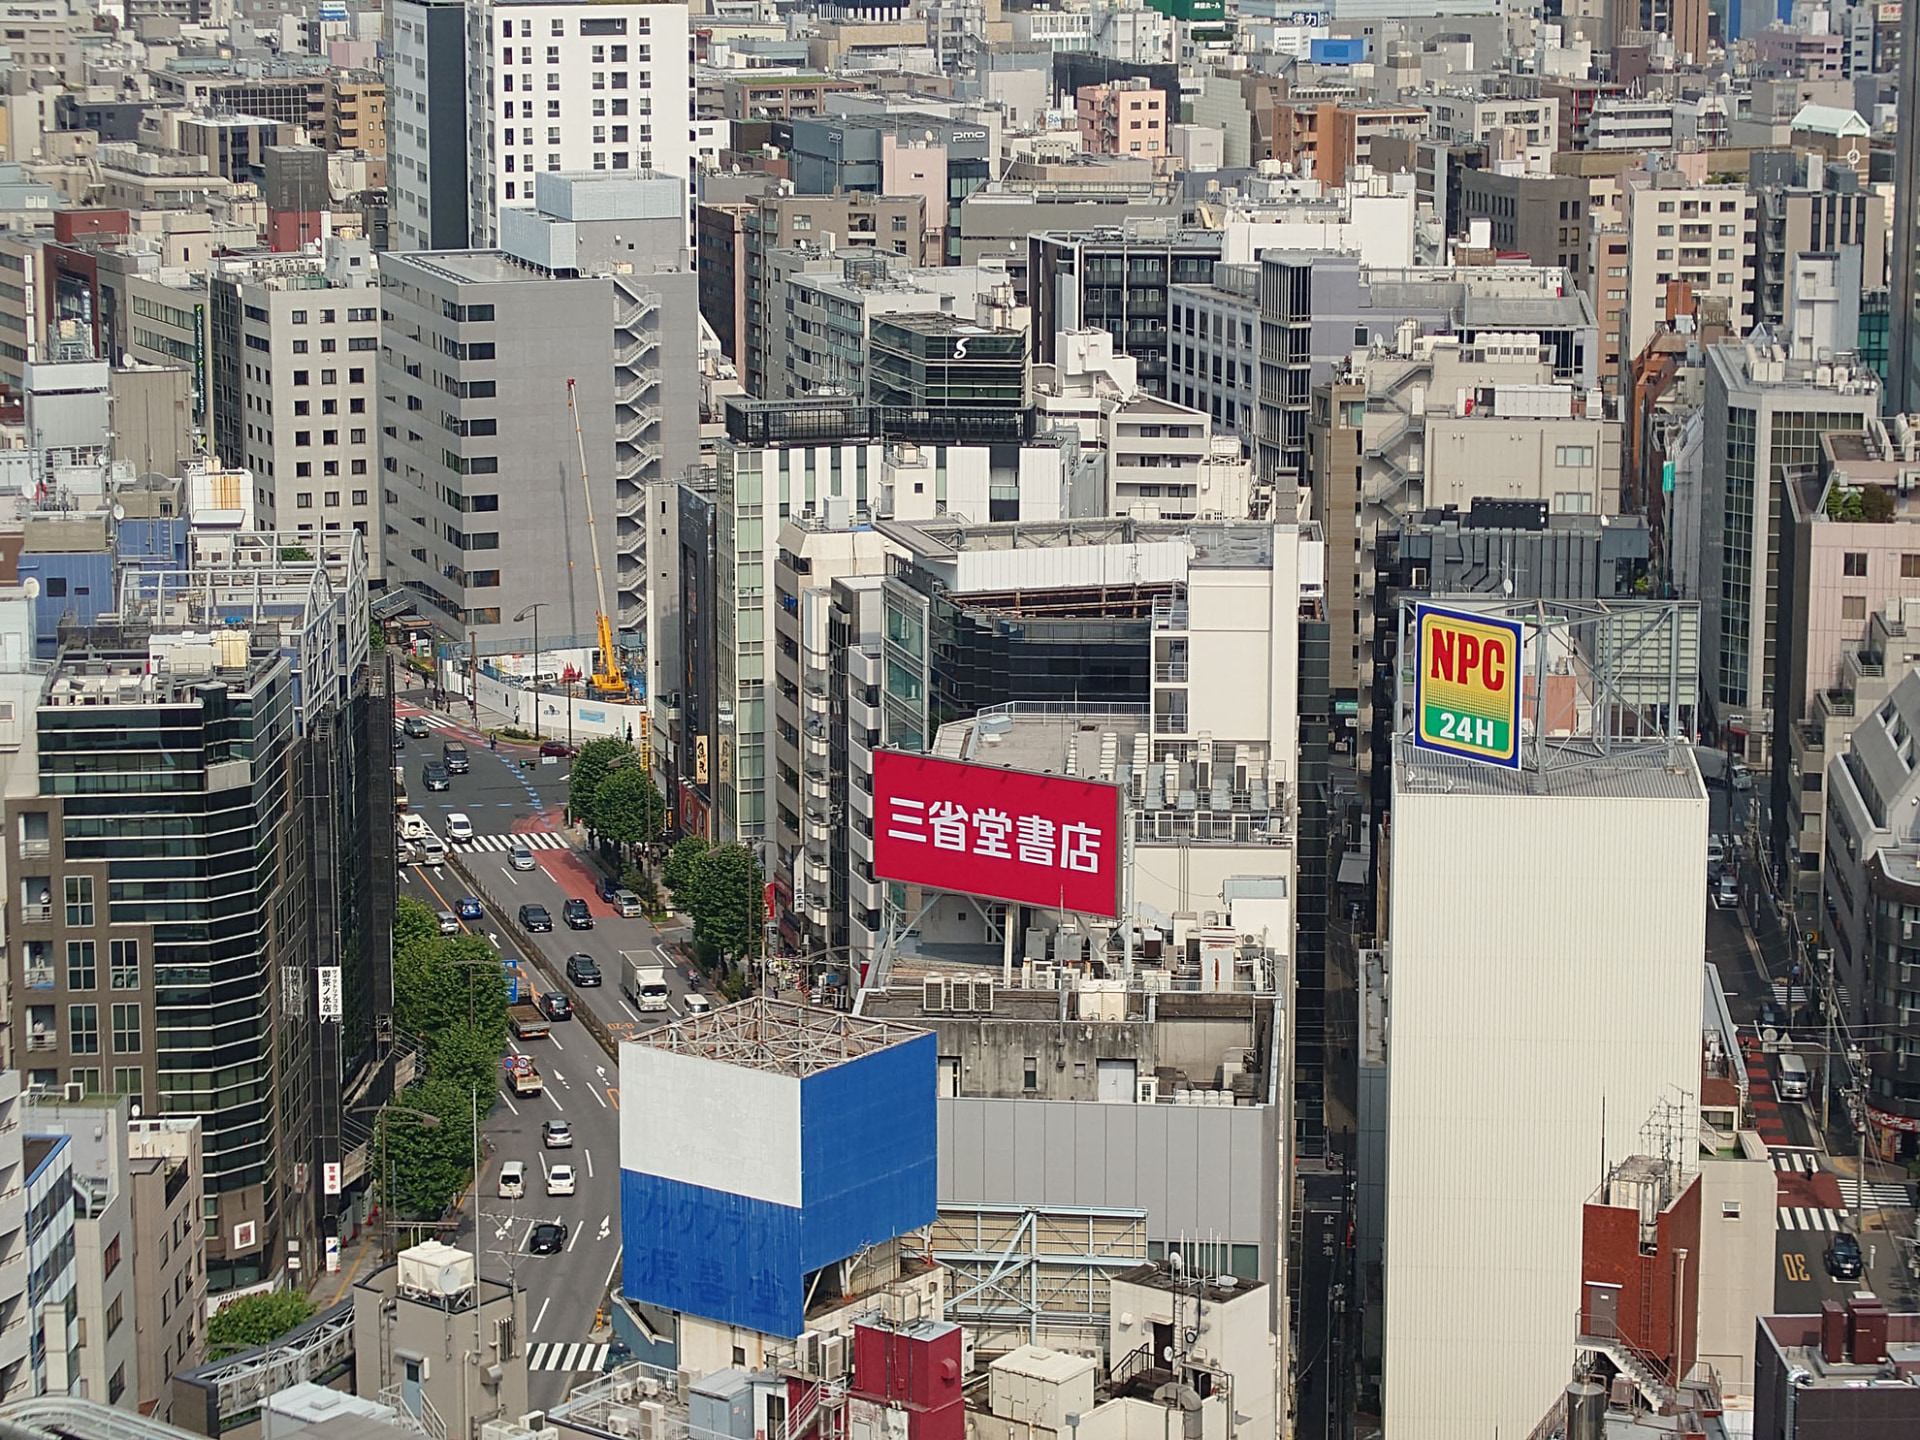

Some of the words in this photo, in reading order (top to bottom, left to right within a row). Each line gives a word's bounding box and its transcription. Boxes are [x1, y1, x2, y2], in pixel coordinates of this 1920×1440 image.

[1431, 628, 1505, 692] NPC
[1440, 712, 1494, 748] 24H
[888, 797, 1102, 873] 三省堂書店
[322, 970, 331, 1013] 御茶ノ水店
[1323, 1214, 1334, 1256] 止まれ
